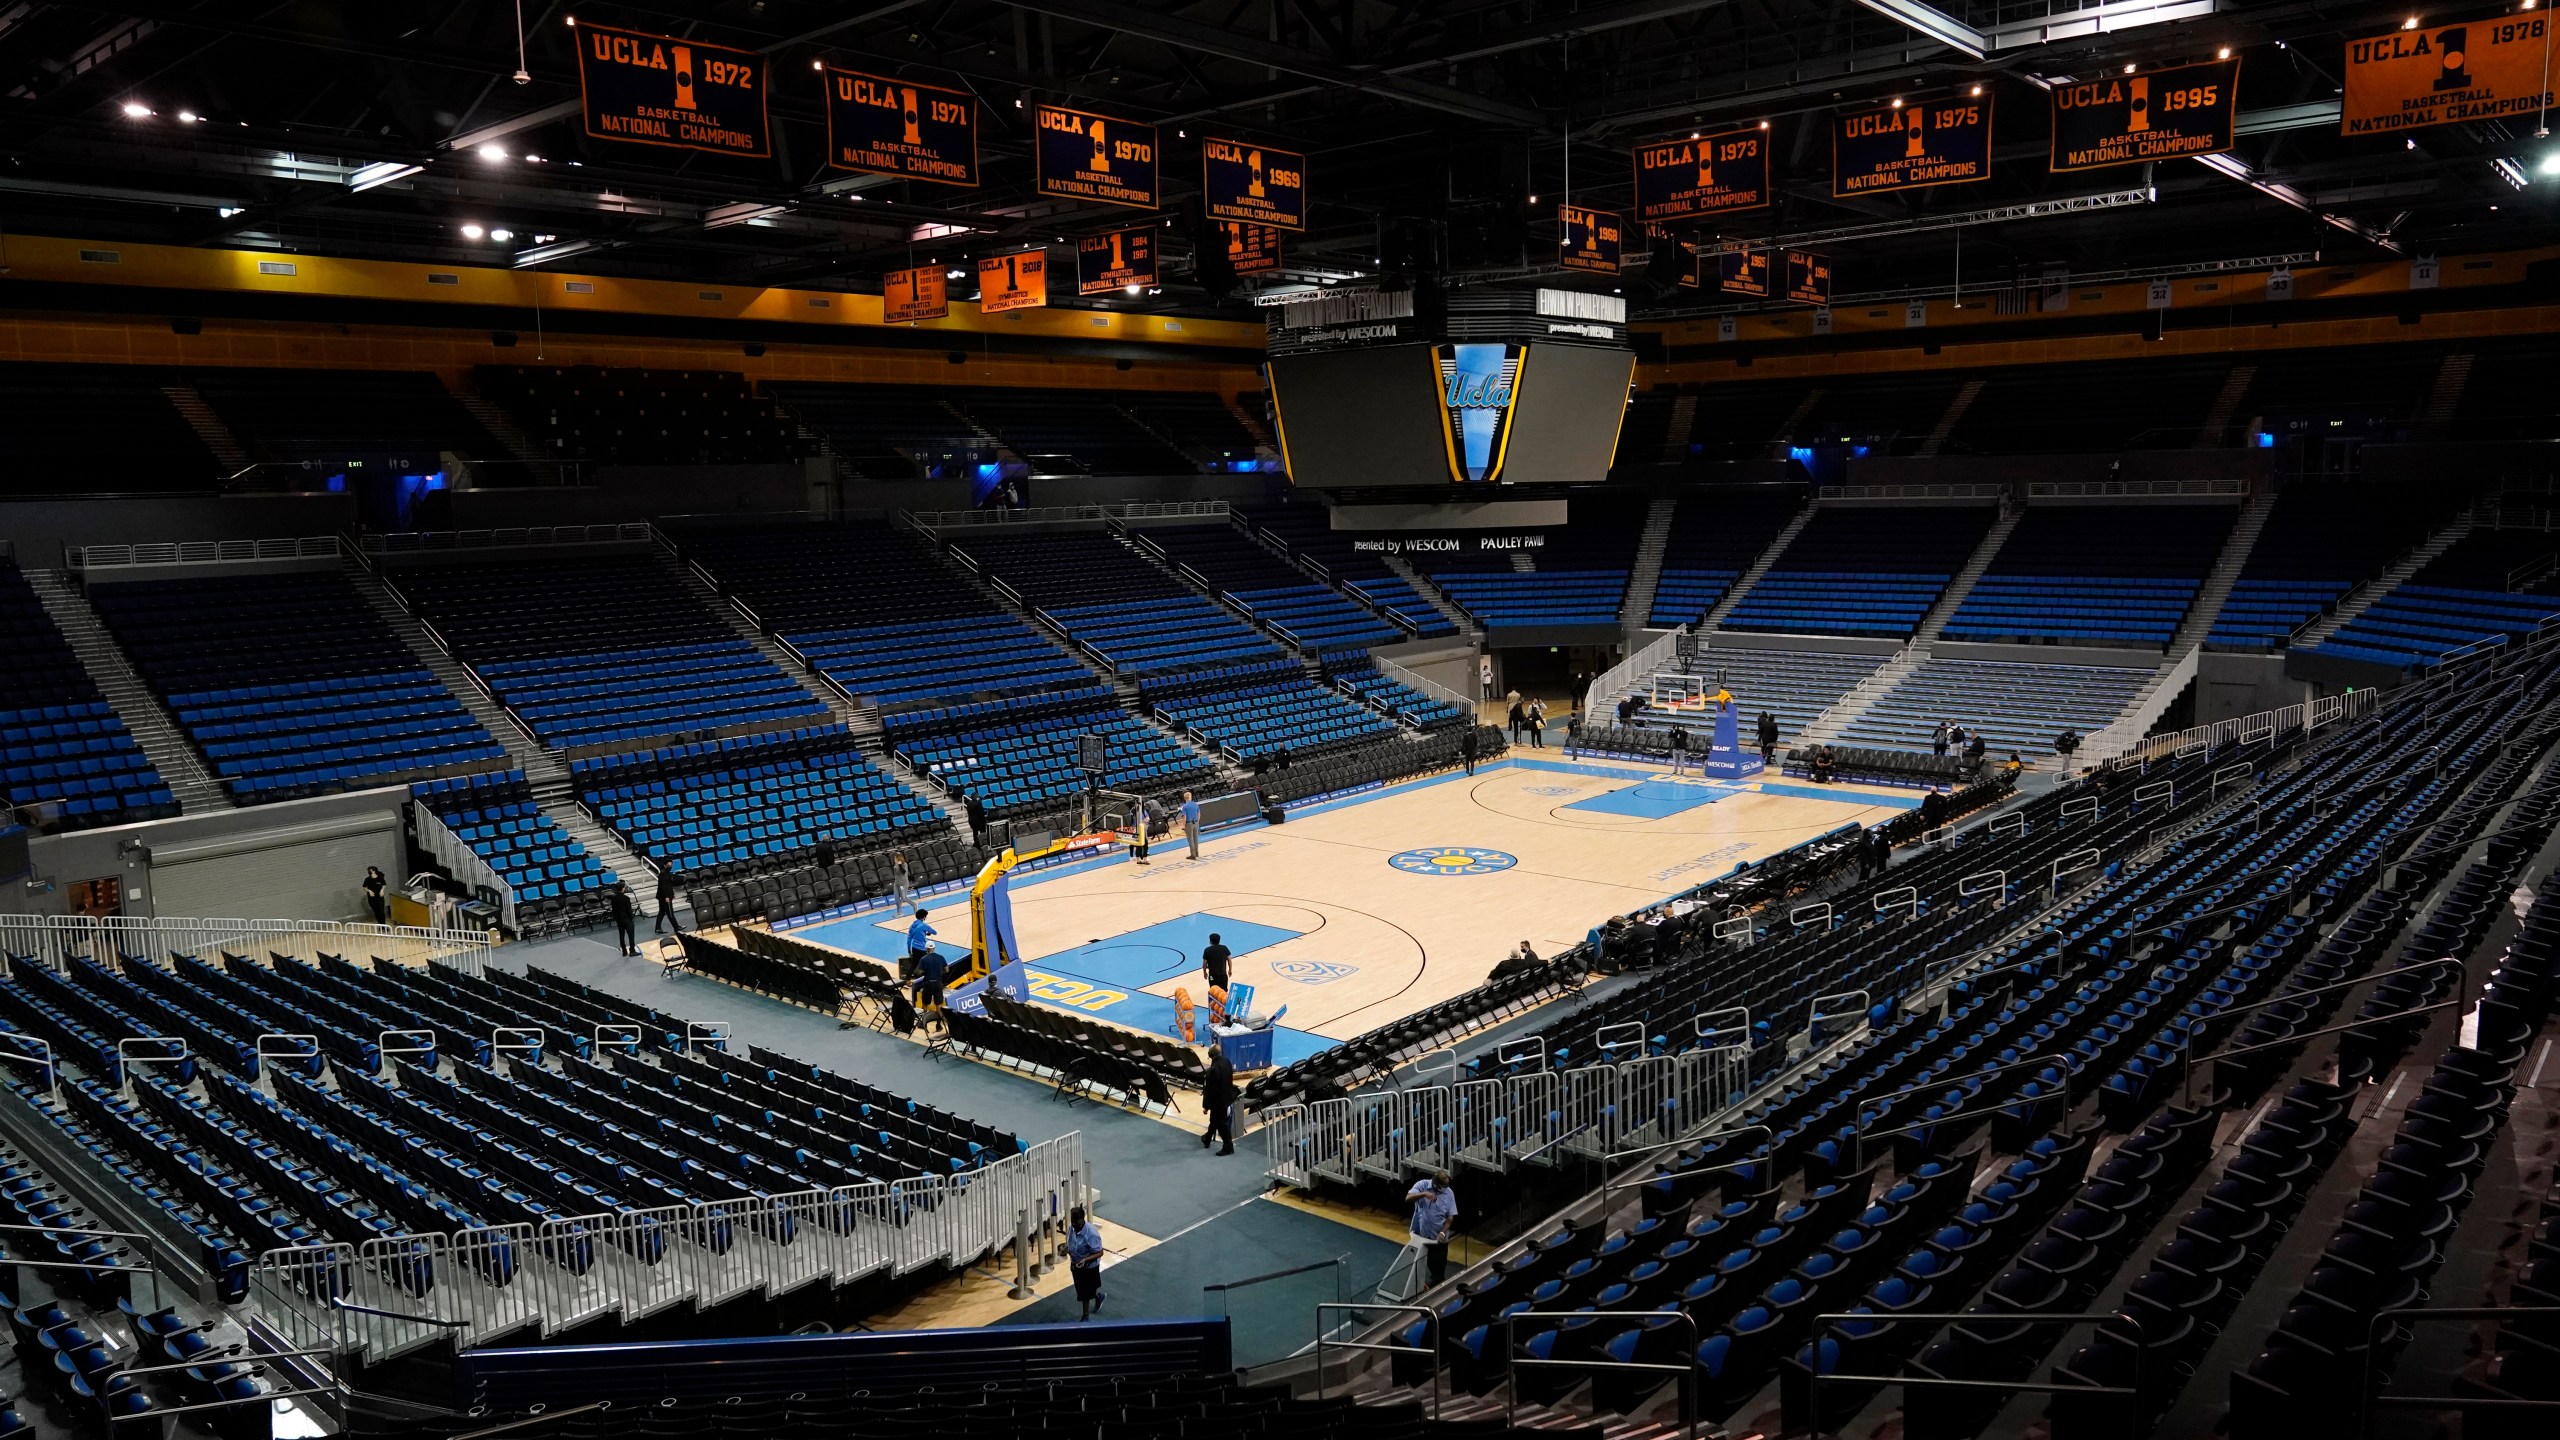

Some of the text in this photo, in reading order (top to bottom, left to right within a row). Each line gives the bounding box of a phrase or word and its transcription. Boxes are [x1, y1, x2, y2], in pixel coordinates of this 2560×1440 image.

[2353, 20, 2544, 91] UCLA 1 1978
[593, 33, 752, 110] UCLA 1 1972
[838, 77, 967, 145] UCLA 1 1971
[2057, 77, 2218, 133] UCLA 1 1995
[2350, 92, 2554, 132] NATIONAL CHAMPIONS
[2402, 88, 2494, 111] BASKETBALL
[637, 105, 720, 127] BASKETBALL
[601, 114, 753, 149] NATIONAL CHAMPIONS
[1040, 110, 1151, 172] UCLA 1 1970
[1845, 106, 1978, 158] UCLA 1 1975
[2100, 129, 2181, 147] BASKETBALL
[873, 140, 940, 159] BASKETBALL
[2068, 134, 2213, 165] NATIONAL CHAMPIONS
[843, 147, 966, 179] NATIONAL CHAMPIONS
[1207, 142, 1300, 197] UCLA 1 1969
[1643, 139, 1757, 187] UCLA 1 1973
[1846, 161, 1976, 190] NATIONAL CHAMPIONS
[1875, 155, 1946, 172] BASKETBALL
[1047, 178, 1150, 202] NATIONAL CHAMPIONS
[1075, 170, 1123, 186] BASKETBALL
[1236, 196, 1275, 210] BASKETBALL
[1645, 190, 1757, 216] NATIONAL CHAMPIONS
[1671, 185, 1731, 200] BASKETBALL
[1213, 204, 1298, 225] NATIONAL CHAMPIONS
[1228, 223, 1243, 254] 1
[1561, 209, 1583, 225] UCLA
[1586, 213, 1596, 250] 1
[1080, 234, 1125, 270] UCLA 1
[885, 273, 908, 286] UCLA
[980, 259, 1003, 272] UCLA
[1005, 257, 1018, 291] 1
[1082, 274, 1153, 290] NATIONAL CHAMPIONS
[1100, 268, 1133, 279] GYMNASTICS
[2418, 268, 2431, 279] 11
[1575, 292, 1600, 320] PAULEY
[1347, 325, 1397, 340] WESCOM
[1388, 539, 1401, 554] by
[1406, 539, 1460, 551] WESCOM
[1481, 537, 1522, 550] PAULEY
[1647, 773, 1763, 791] UCLA
[961, 998, 983, 1009] UCLA
